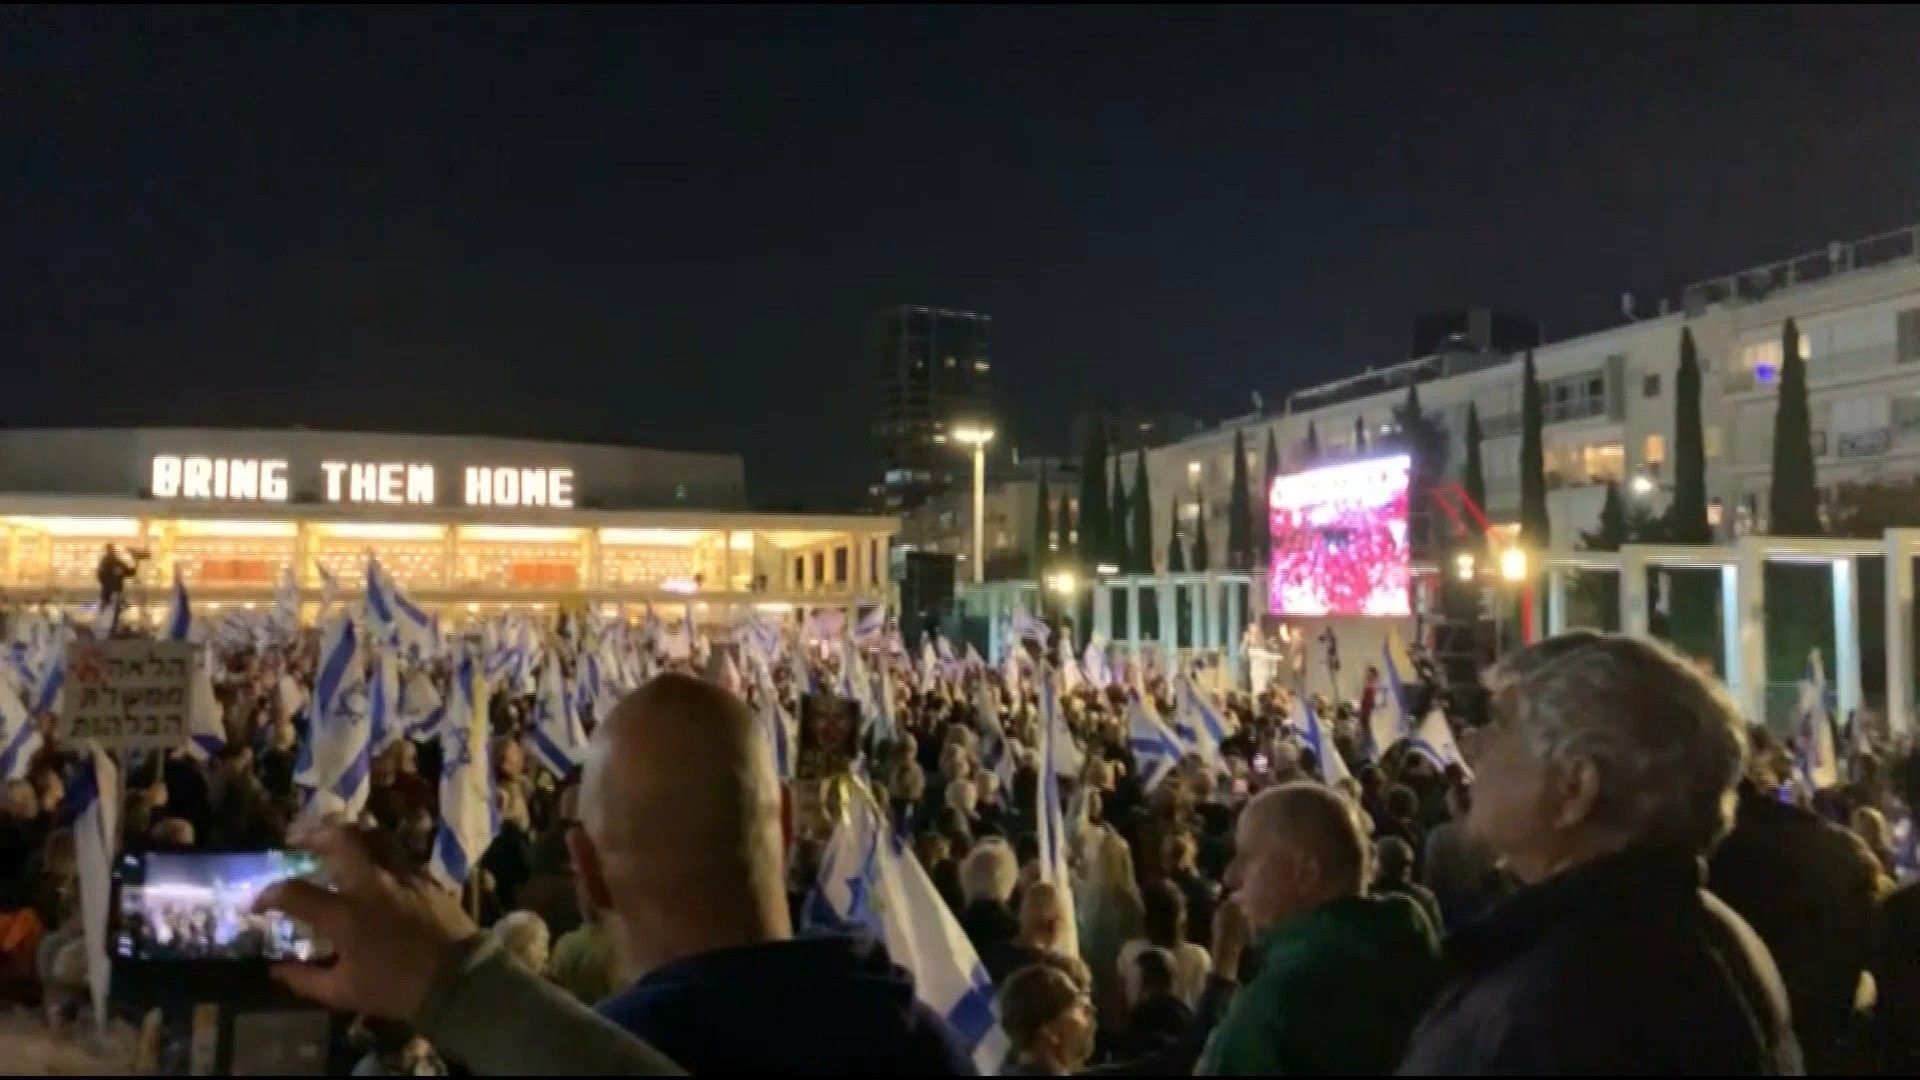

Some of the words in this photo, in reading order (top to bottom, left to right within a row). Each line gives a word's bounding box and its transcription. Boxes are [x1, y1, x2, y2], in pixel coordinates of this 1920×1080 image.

[152, 456, 288, 500] BRING
[322, 461, 435, 503] THEM
[465, 467, 574, 508] HOME
[80, 683, 183, 706] ממשלת
